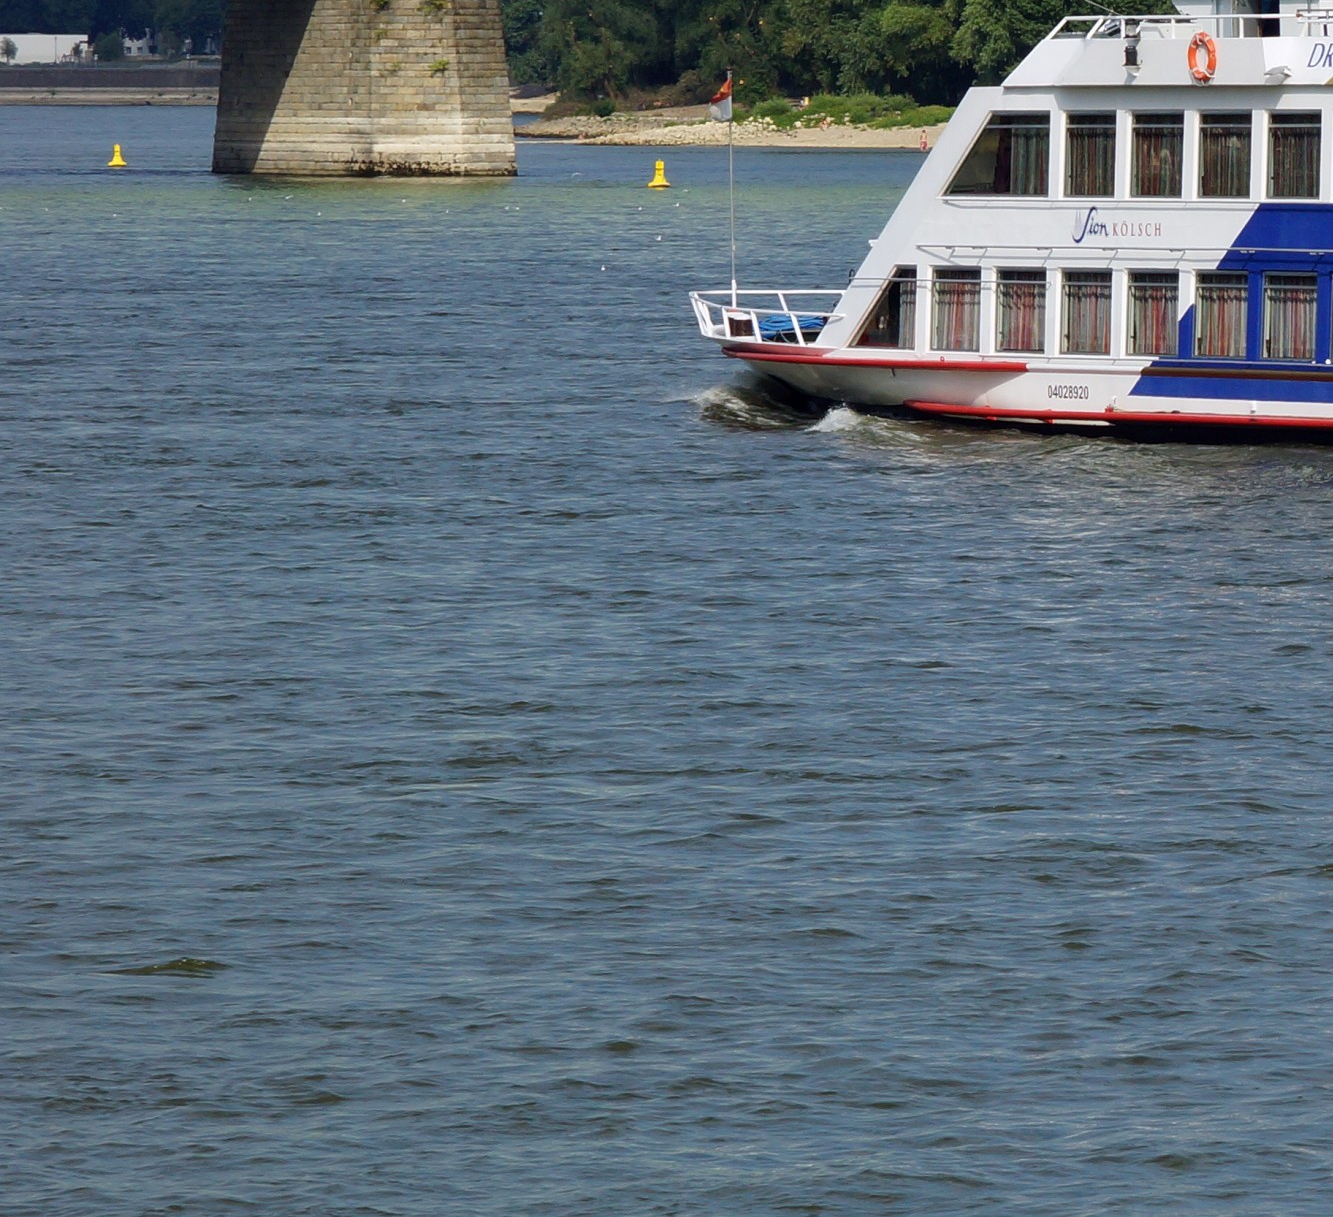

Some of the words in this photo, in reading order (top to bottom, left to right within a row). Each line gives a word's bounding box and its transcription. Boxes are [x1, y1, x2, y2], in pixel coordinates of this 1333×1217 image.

[1072, 206, 1109, 243] Sion
[1112, 220, 1162, 237] KÖLSCH
[1047, 384, 1089, 400] 04028920
